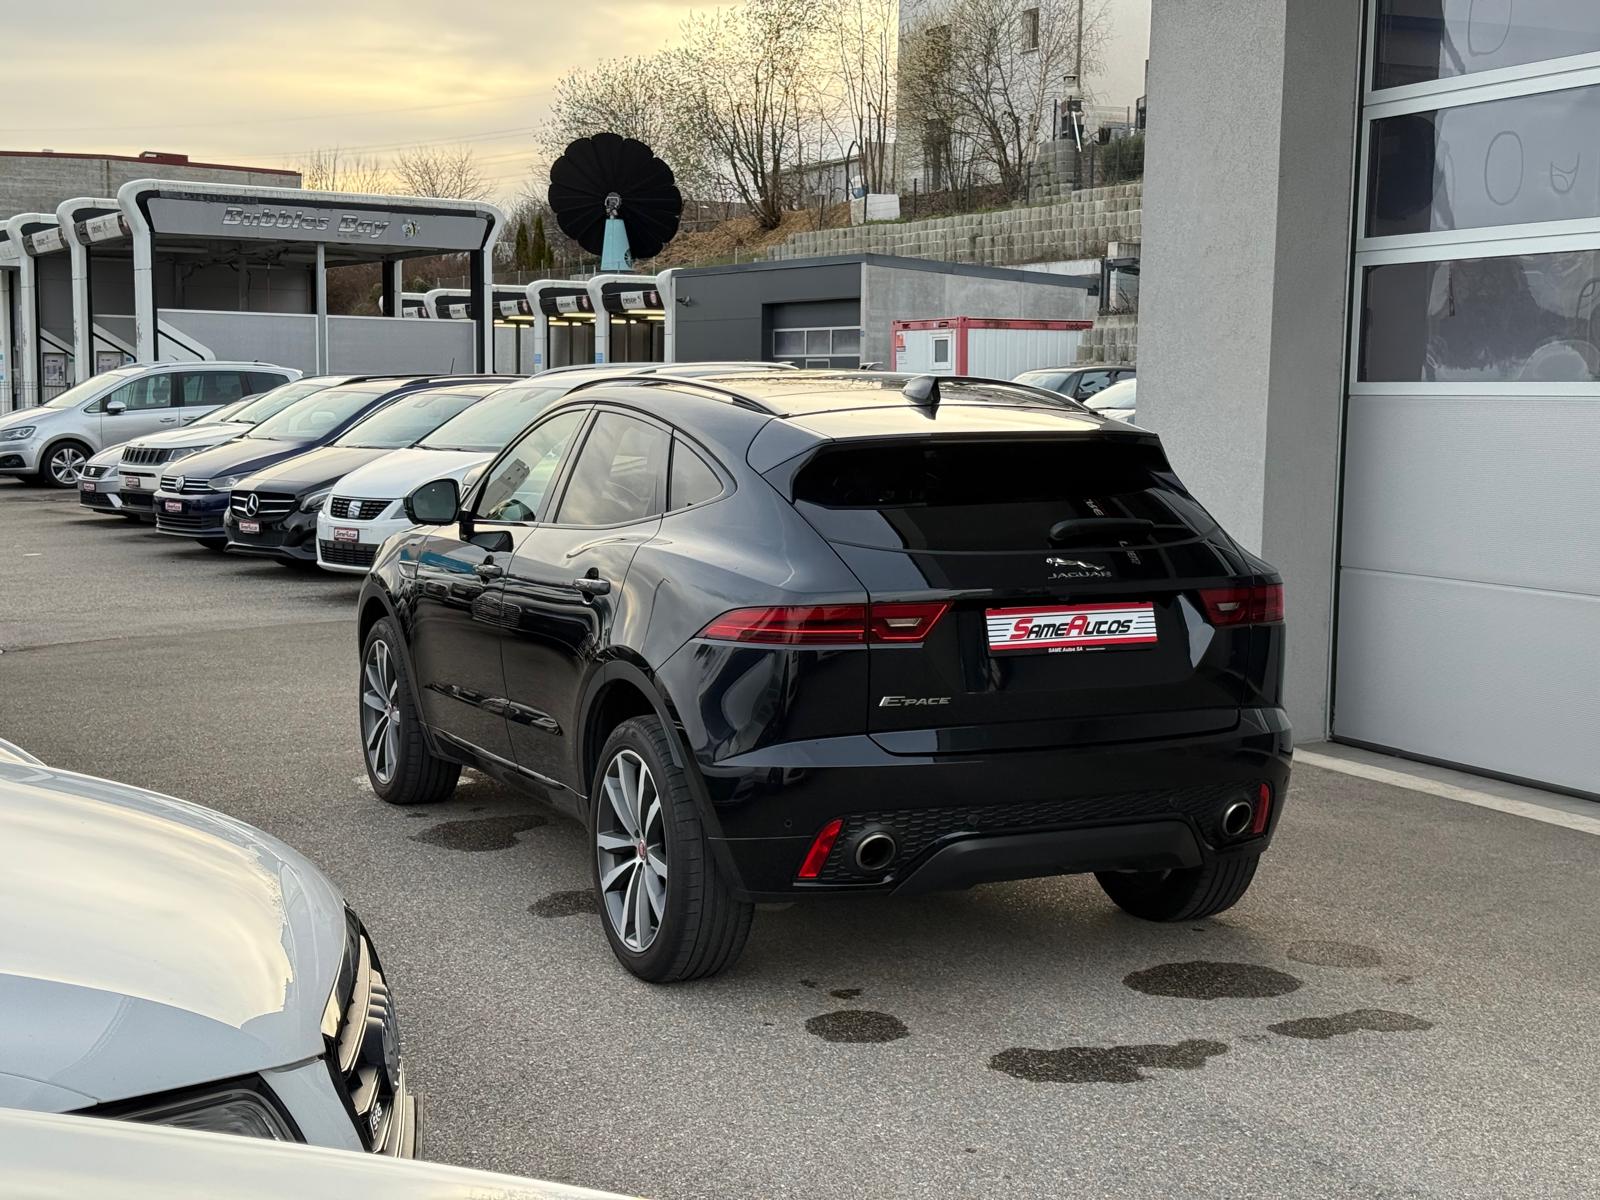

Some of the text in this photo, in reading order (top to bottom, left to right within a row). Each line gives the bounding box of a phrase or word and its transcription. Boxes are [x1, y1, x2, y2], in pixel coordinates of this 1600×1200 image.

[222, 206, 391, 239] Bubbles Bay
[1048, 571, 1113, 579] JAGUAR
